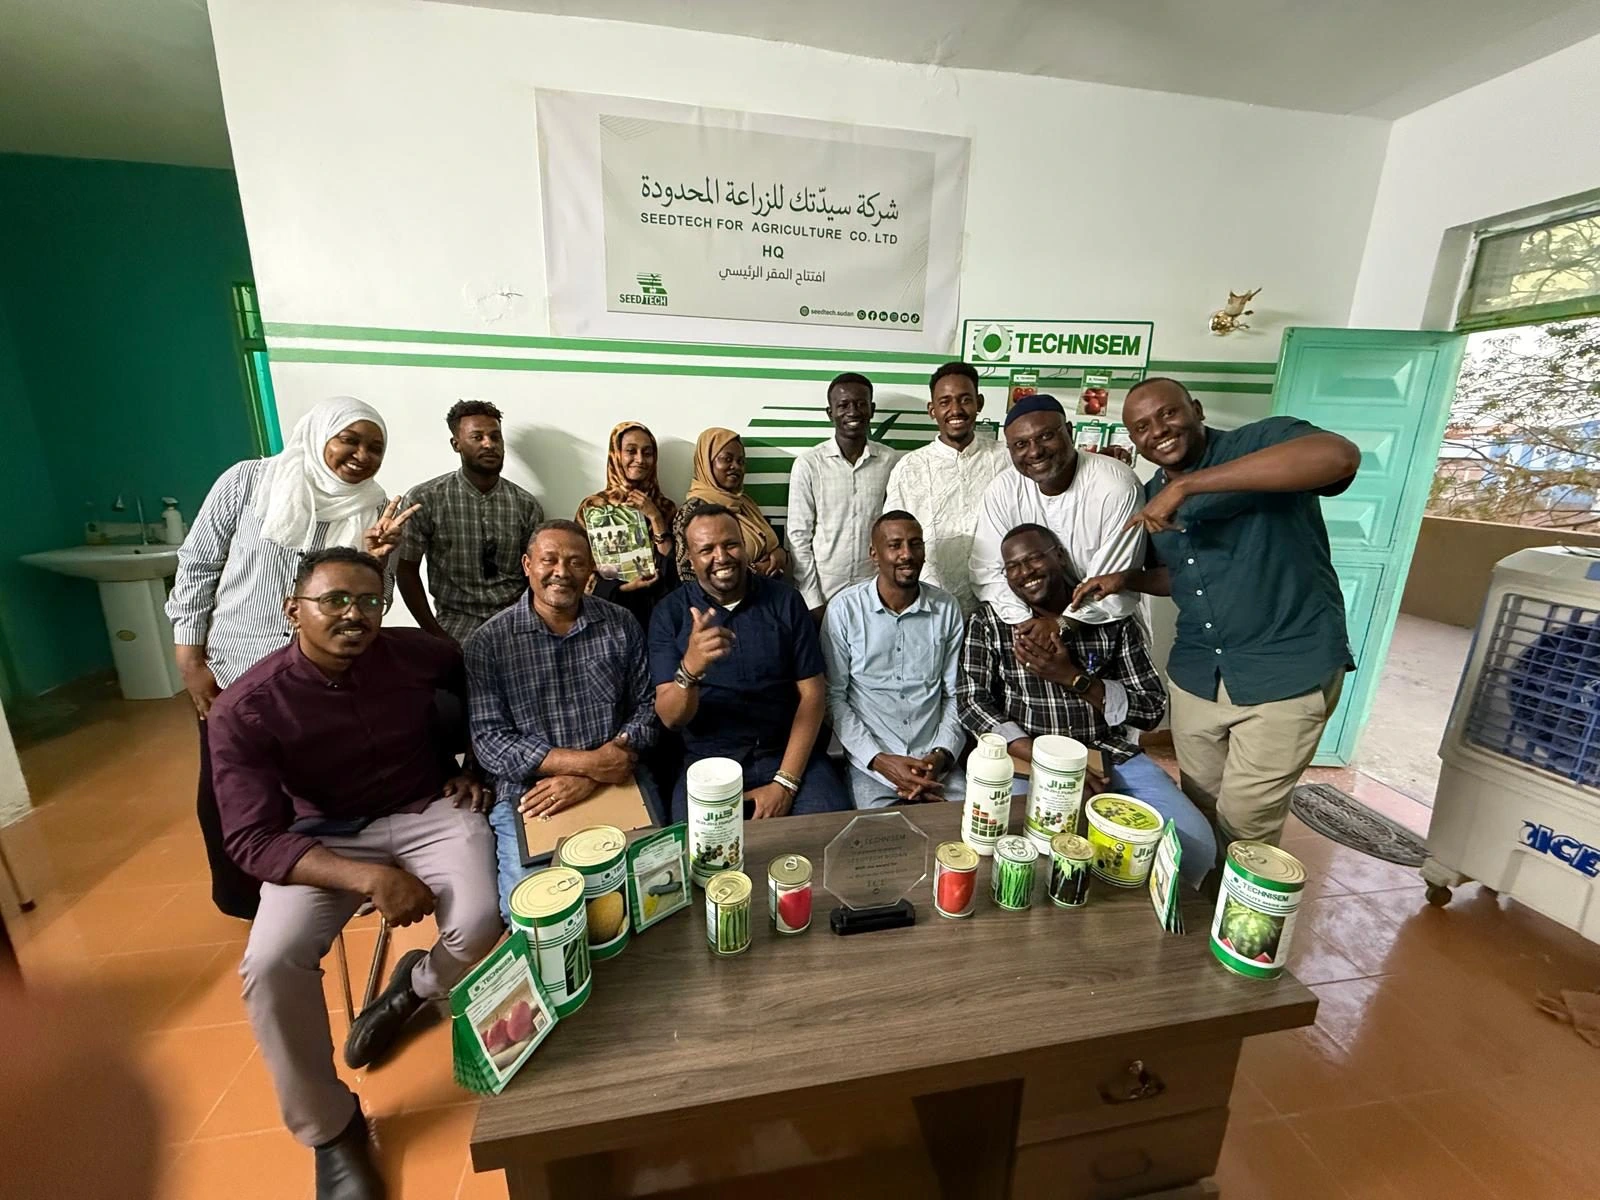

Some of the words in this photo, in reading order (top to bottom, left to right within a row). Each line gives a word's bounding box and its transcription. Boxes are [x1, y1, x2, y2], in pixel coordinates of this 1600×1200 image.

[641, 175, 720, 207] المحدودة
[725, 181, 784, 217] للزراعة
[857, 192, 899, 227] شركة
[640, 212, 712, 228] SEEDTECH
[717, 219, 744, 231] FOR
[752, 222, 842, 240] AGRICULTURE
[849, 230, 871, 243] CO.
[875, 233, 898, 244] LTD
[762, 245, 784, 259] HQ
[718, 265, 763, 280] الرئيسي
[766, 268, 793, 281] المقر
[795, 269, 826, 286] افتتاح
[1015, 333, 1141, 356] TECHNISEM
[1243, 881, 1289, 903] TECHNISEM
